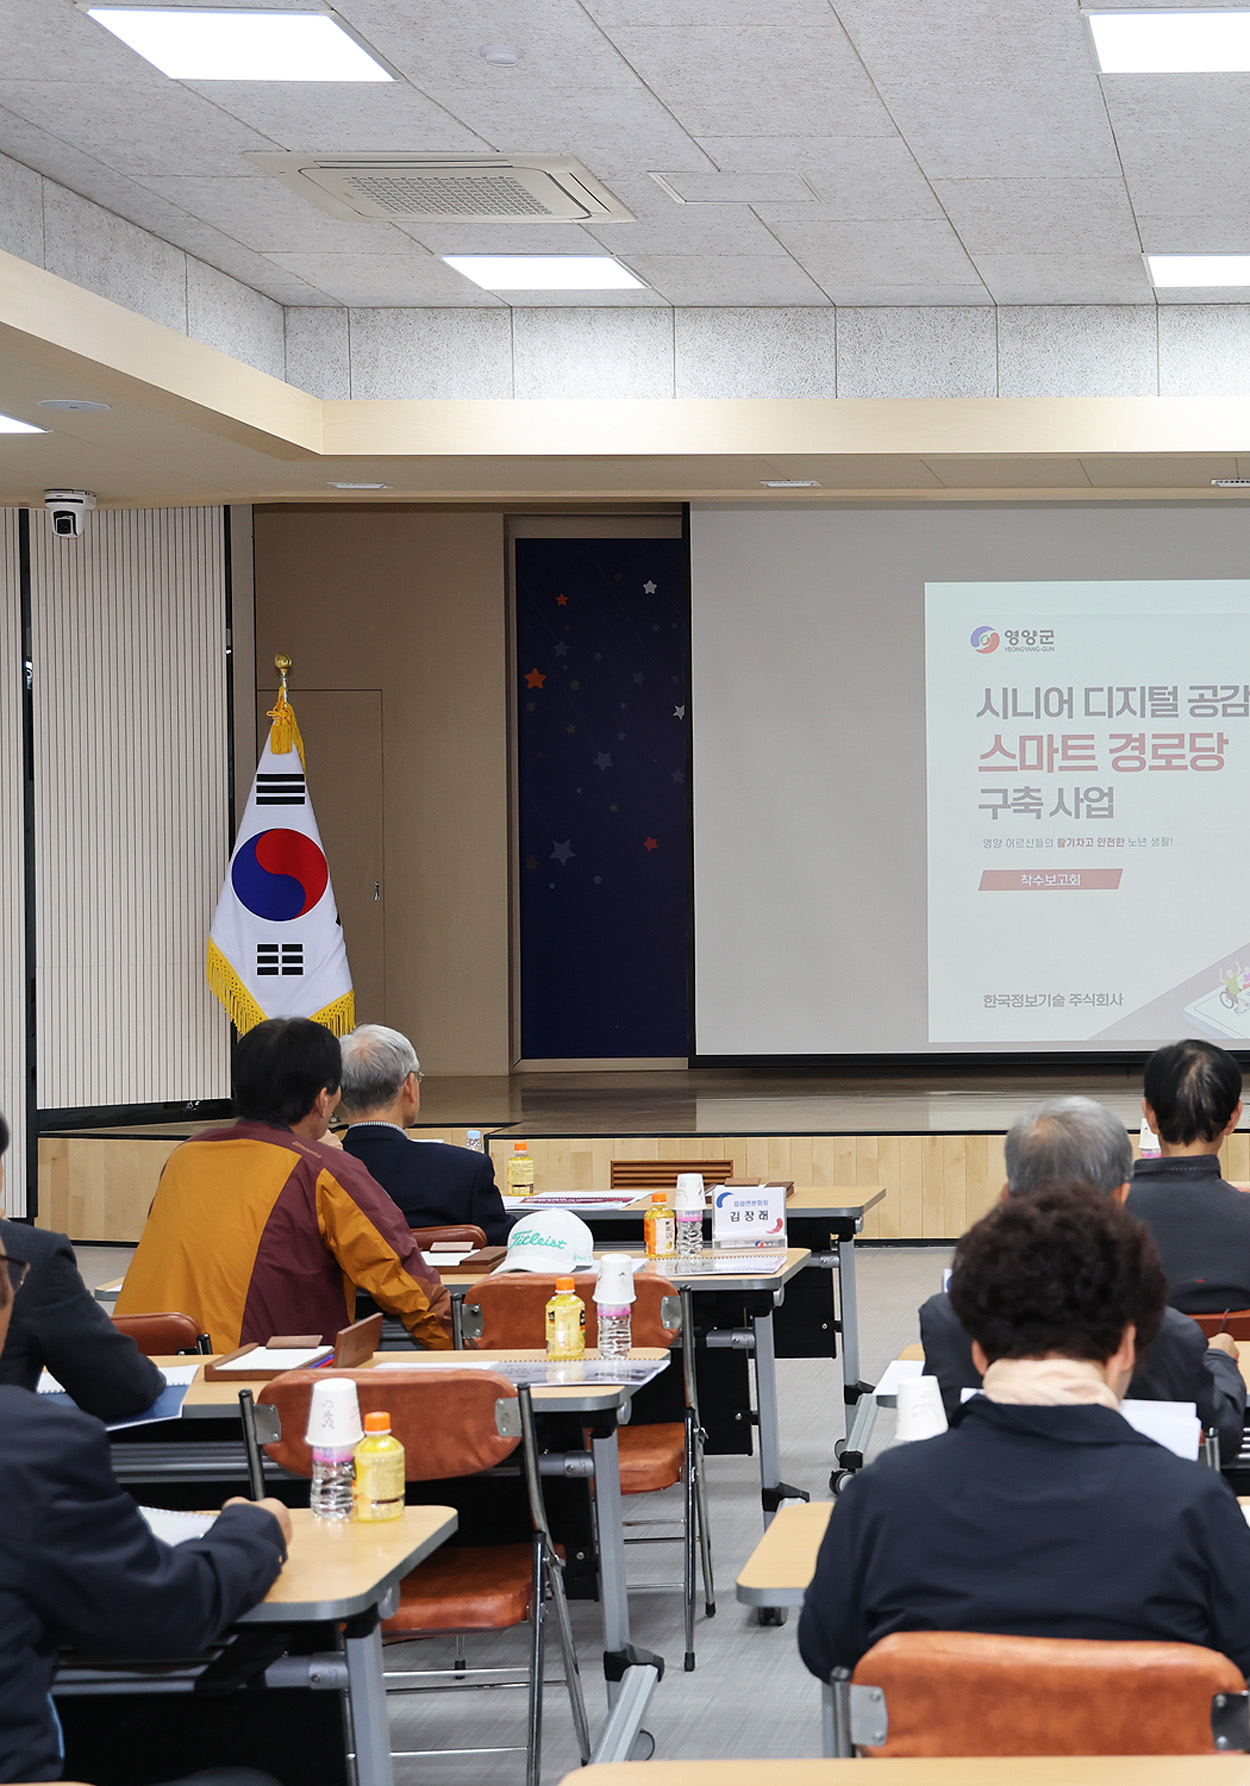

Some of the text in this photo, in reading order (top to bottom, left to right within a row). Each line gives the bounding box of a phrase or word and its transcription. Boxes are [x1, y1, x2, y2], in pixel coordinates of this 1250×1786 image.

[1004, 629, 1055, 646] 영양군
[977, 687, 1073, 719] 시니어
[1085, 686, 1179, 718] 디지털
[978, 732, 1229, 773] 스마트 경로당
[979, 786, 1113, 820] 구축 사업
[982, 836, 1175, 849] 영양 어르신들의 활기차고 안전한 노년 생활!
[1020, 873, 1082, 887] 착수보고회
[983, 992, 1124, 1009] 한국정보기술 주식회사
[507, 1229, 568, 1251] Titleist
